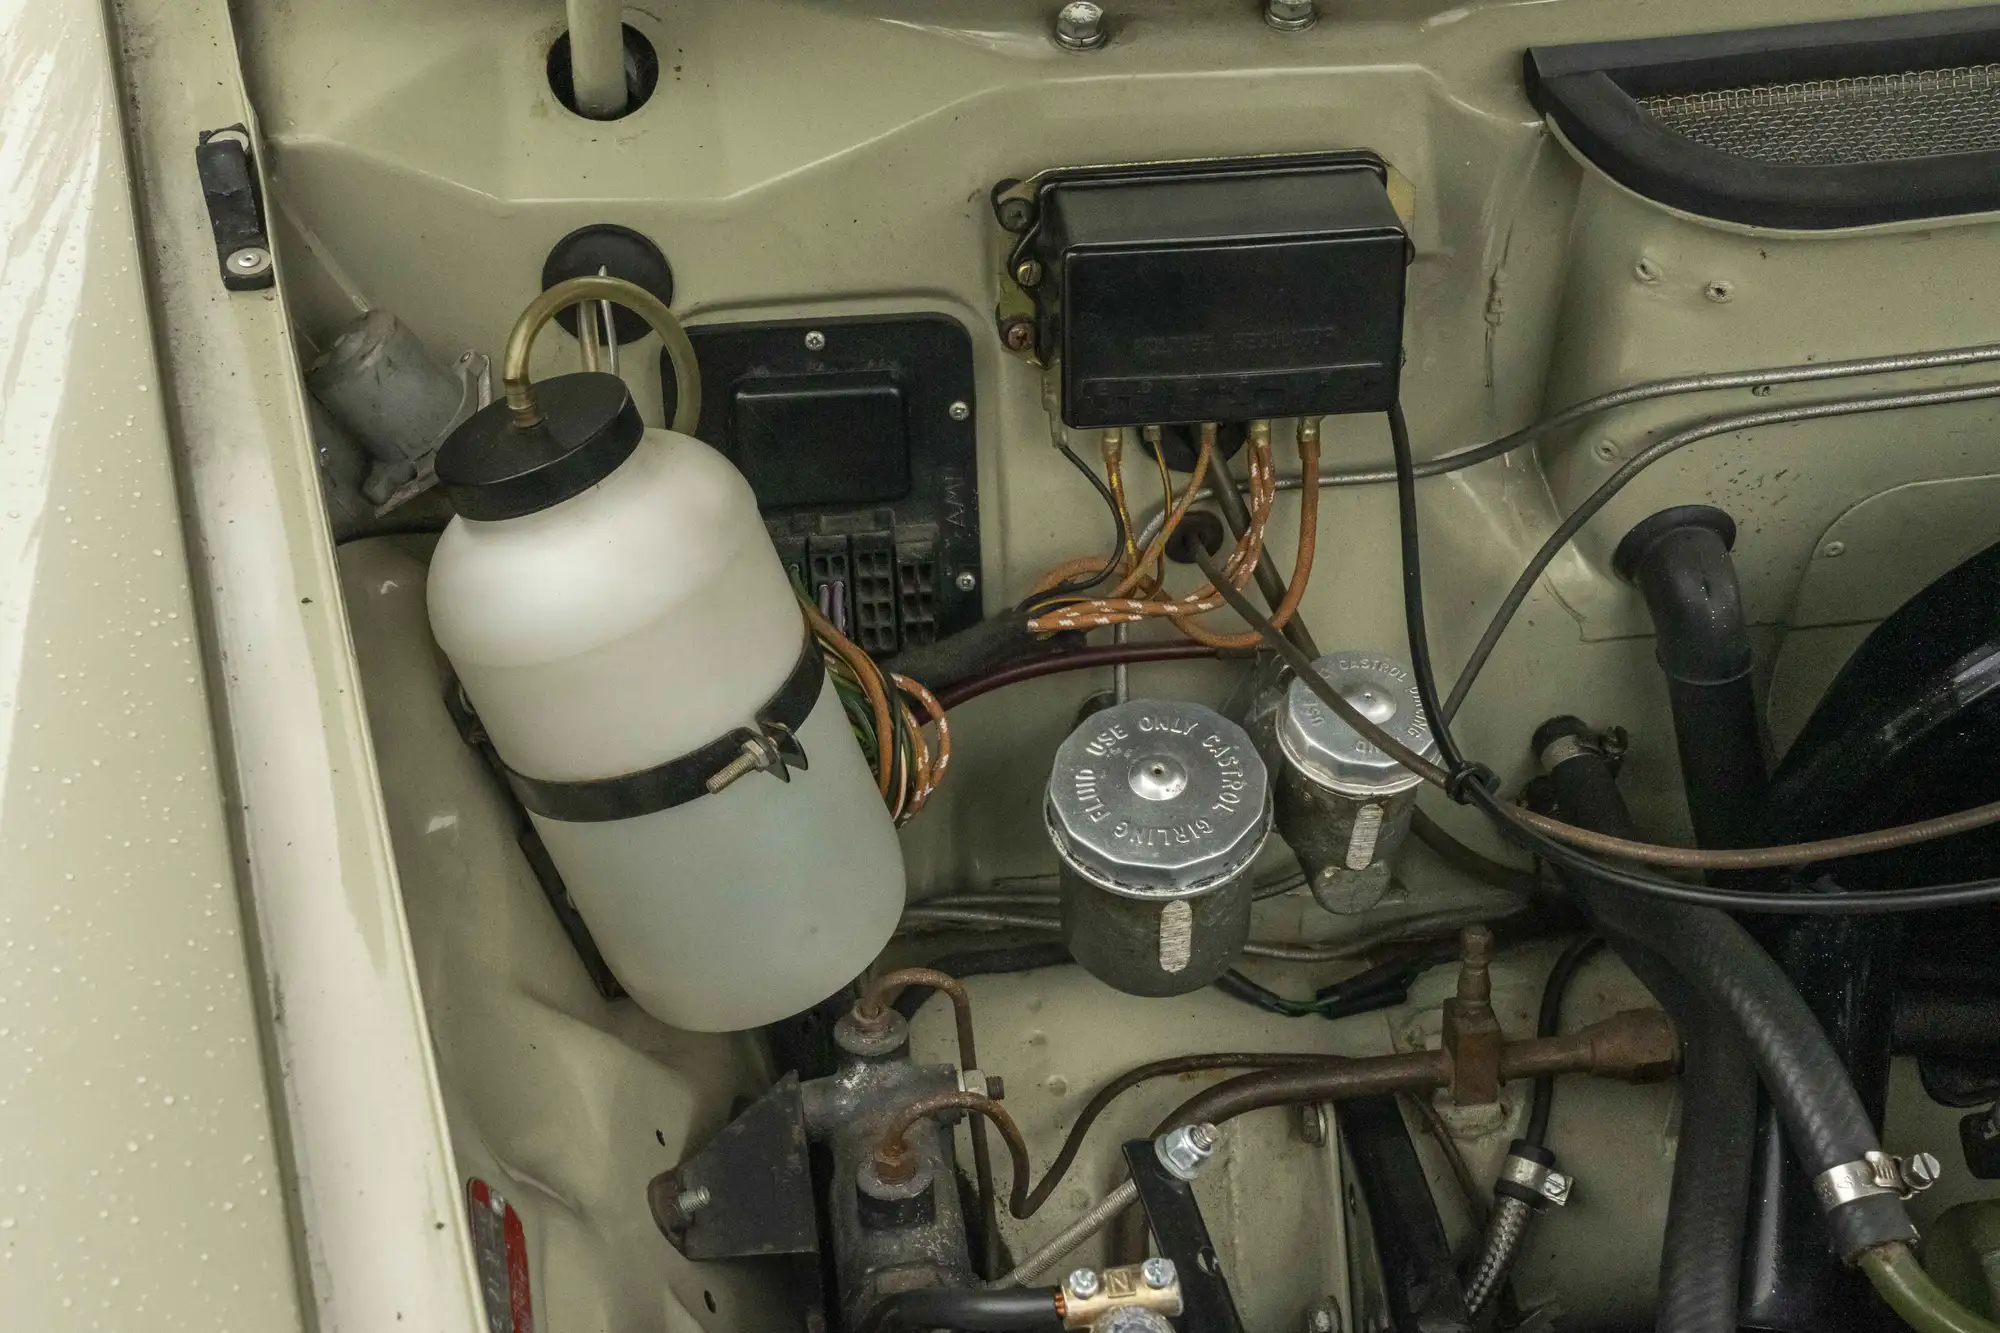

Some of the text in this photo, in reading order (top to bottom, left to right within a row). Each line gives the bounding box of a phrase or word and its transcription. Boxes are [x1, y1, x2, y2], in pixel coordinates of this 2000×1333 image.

[1339, 658, 1408, 683] CASTROL
[1075, 716, 1245, 847] USE ONLY CASTROL GIRLING FLUID
